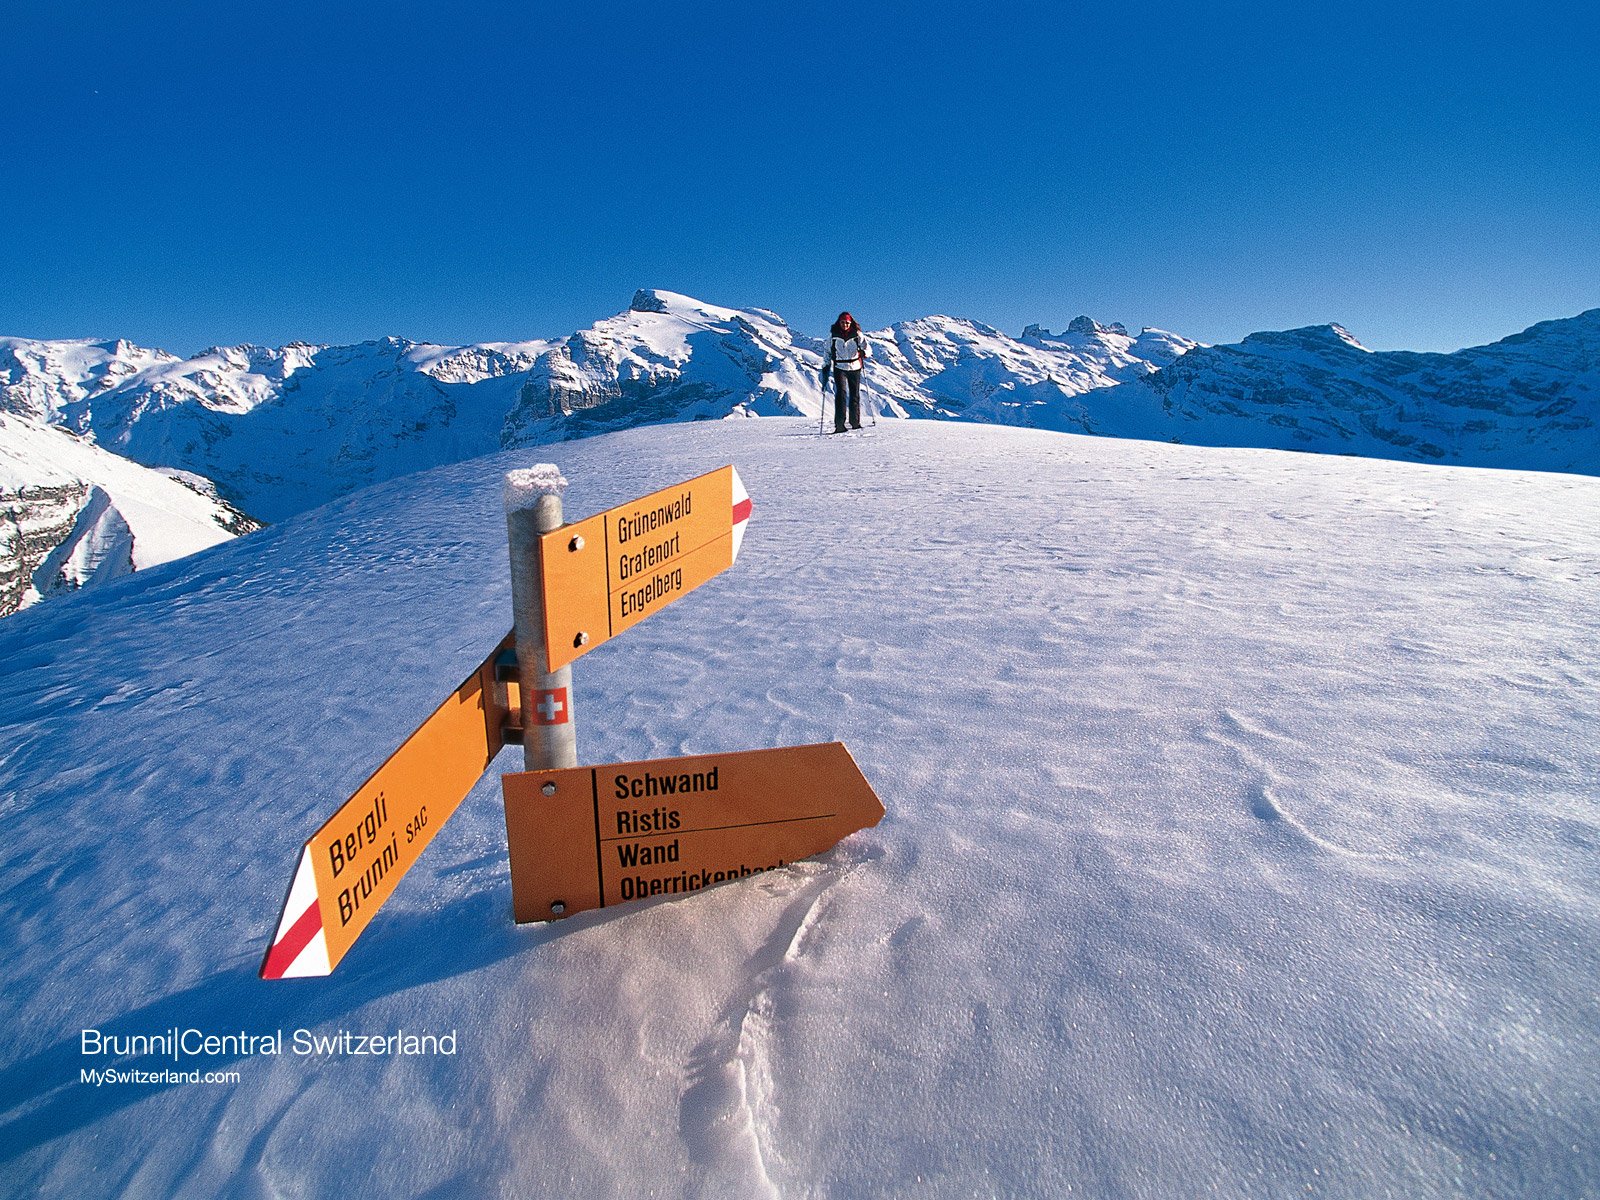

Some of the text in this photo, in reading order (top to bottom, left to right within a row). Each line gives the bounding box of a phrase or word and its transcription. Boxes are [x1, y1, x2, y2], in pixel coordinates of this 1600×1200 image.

[618, 491, 692, 544] Grünenwald
[619, 531, 680, 580] Grafenort
[621, 567, 682, 618] Engelberg
[614, 766, 719, 800] Schwand
[328, 791, 388, 879] Bergli
[616, 807, 681, 835] Ristis
[337, 805, 428, 927] Brunni SAC
[617, 839, 680, 868] Wand
[620, 859, 784, 901] Oberrickenb
